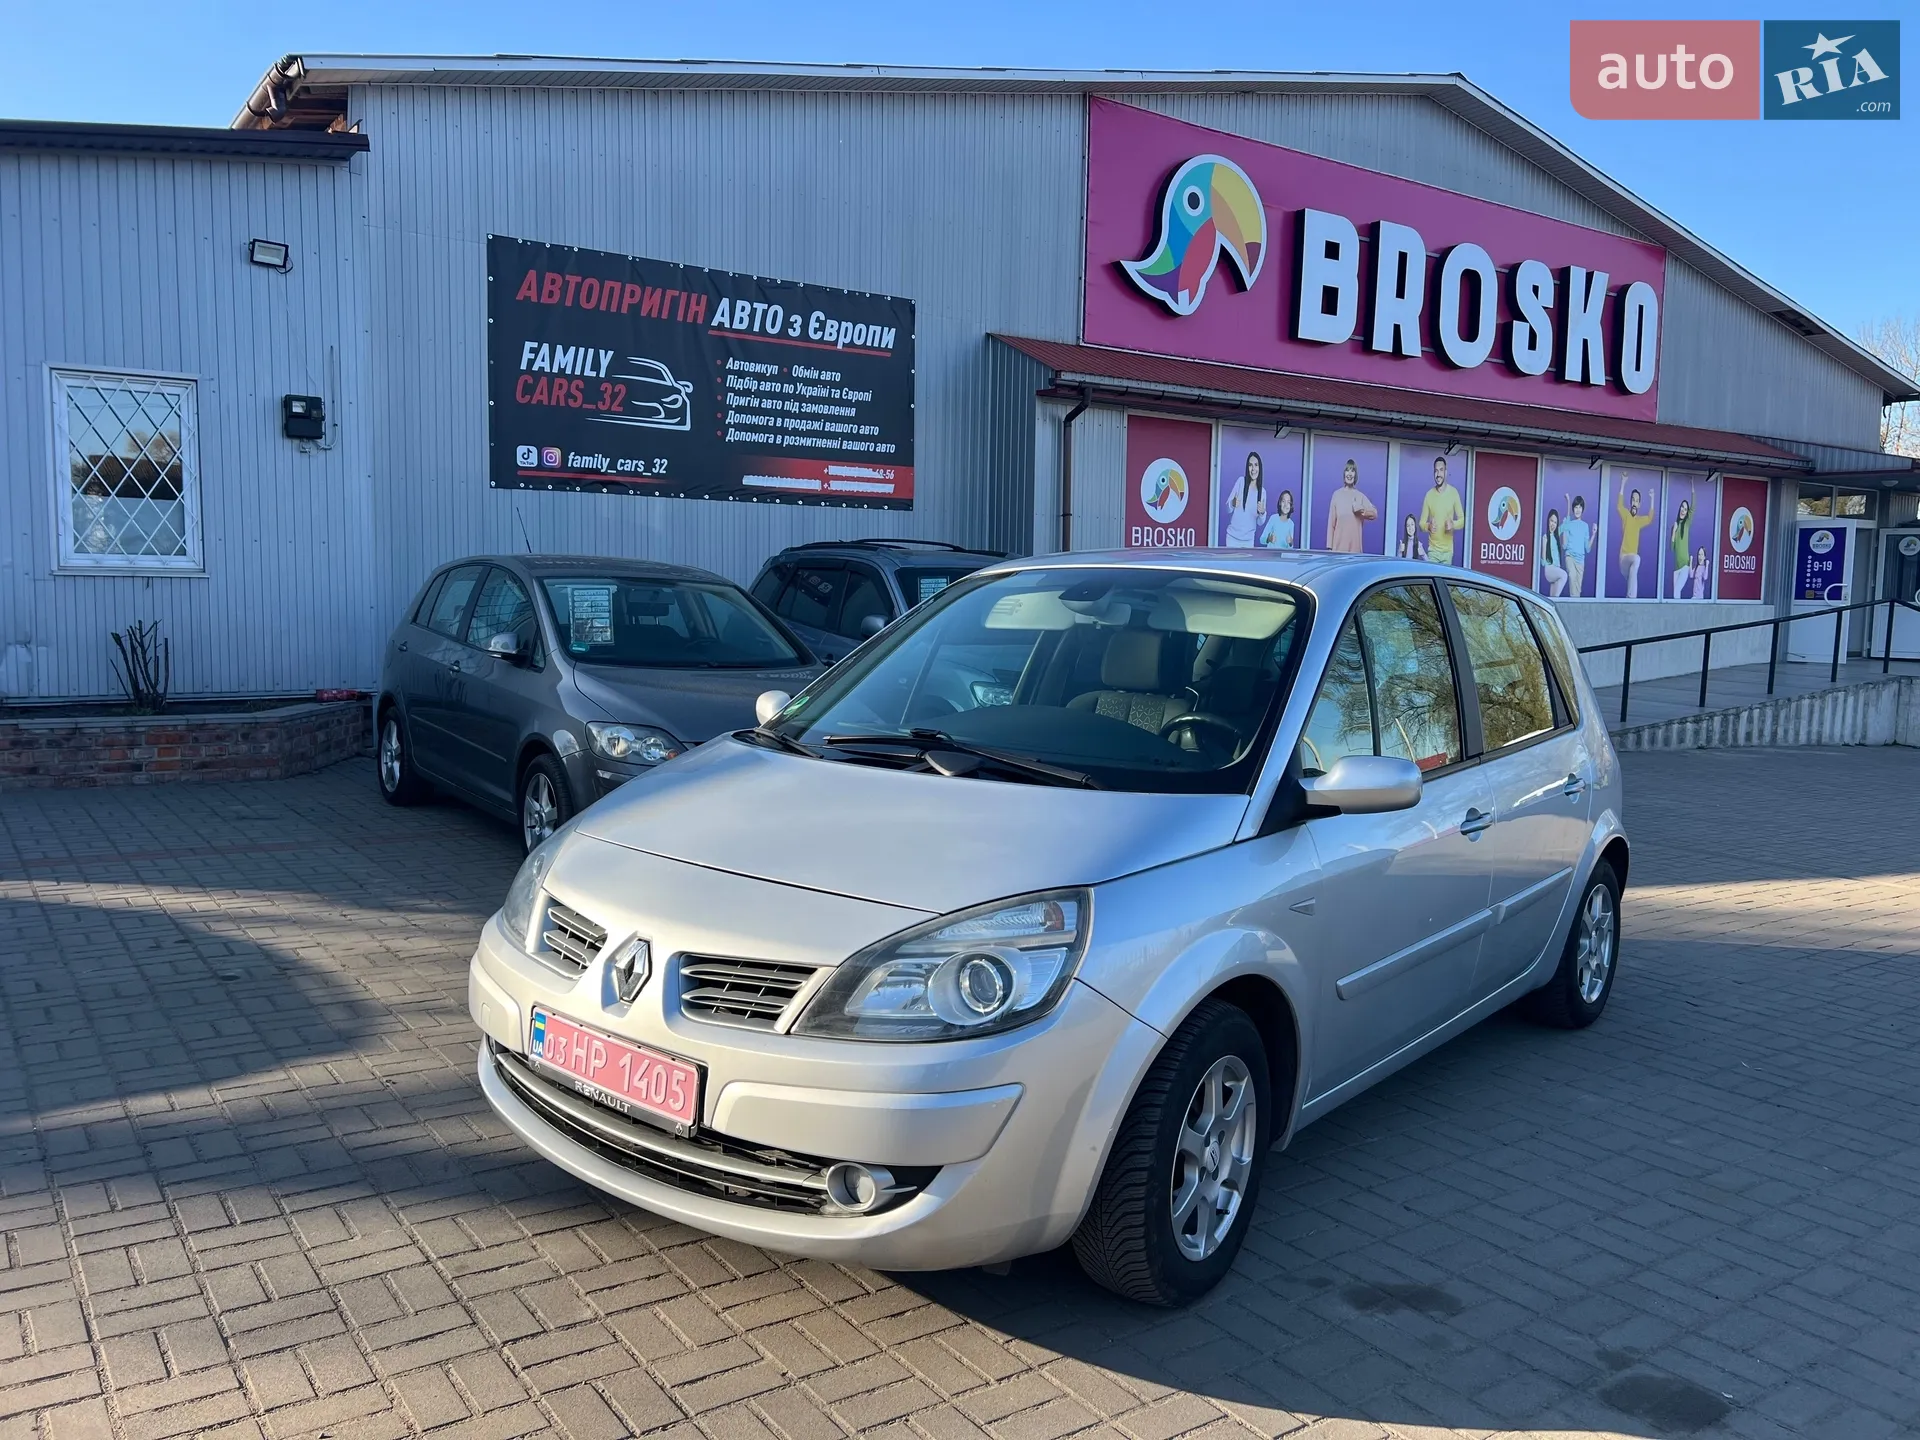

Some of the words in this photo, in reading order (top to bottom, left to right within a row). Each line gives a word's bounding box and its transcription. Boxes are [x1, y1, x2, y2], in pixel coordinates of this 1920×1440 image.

[515, 269, 708, 324] АВТОПРИГІН
[711, 297, 784, 335] АВТО
[787, 314, 803, 337] з
[808, 310, 897, 349] Європи
[1295, 207, 1659, 396] BROSKO
[520, 340, 614, 378] FAMILY
[725, 357, 779, 376] Автовикуп
[791, 364, 819, 381] Обмін
[820, 369, 841, 382] авто
[515, 374, 627, 412] CARS_32
[726, 374, 759, 392] Підбір
[759, 379, 781, 393] авто
[782, 382, 795, 394] по
[796, 382, 829, 398] Україні
[830, 388, 841, 399] та
[842, 387, 873, 402] Європі
[726, 392, 760, 408] Пригін
[761, 397, 783, 410] авто
[784, 398, 800, 413] під
[800, 402, 857, 417] замовлення
[726, 410, 774, 427] Допомога
[776, 416, 783, 427] в
[783, 418, 824, 433] продажі
[825, 422, 858, 434] вашого
[859, 424, 879, 436] авто
[726, 427, 774, 444] Допомога
[775, 434, 782, 444] в
[783, 435, 841, 449] розмитненні
[842, 438, 875, 452] вашого
[875, 442, 896, 453] авто
[568, 452, 668, 476] family_cars_32
[1131, 526, 1195, 547] BROSKO
[1480, 542, 1525, 561] BROSKO
[1723, 554, 1756, 570] BROSKO
[1813, 560, 1833, 571] 9-19
[532, 1040, 544, 1056] UA
[545, 1032, 568, 1066] 03
[571, 1031, 608, 1079] HP
[618, 1052, 688, 1112] 1405
[574, 1080, 633, 1114] RENAULT
